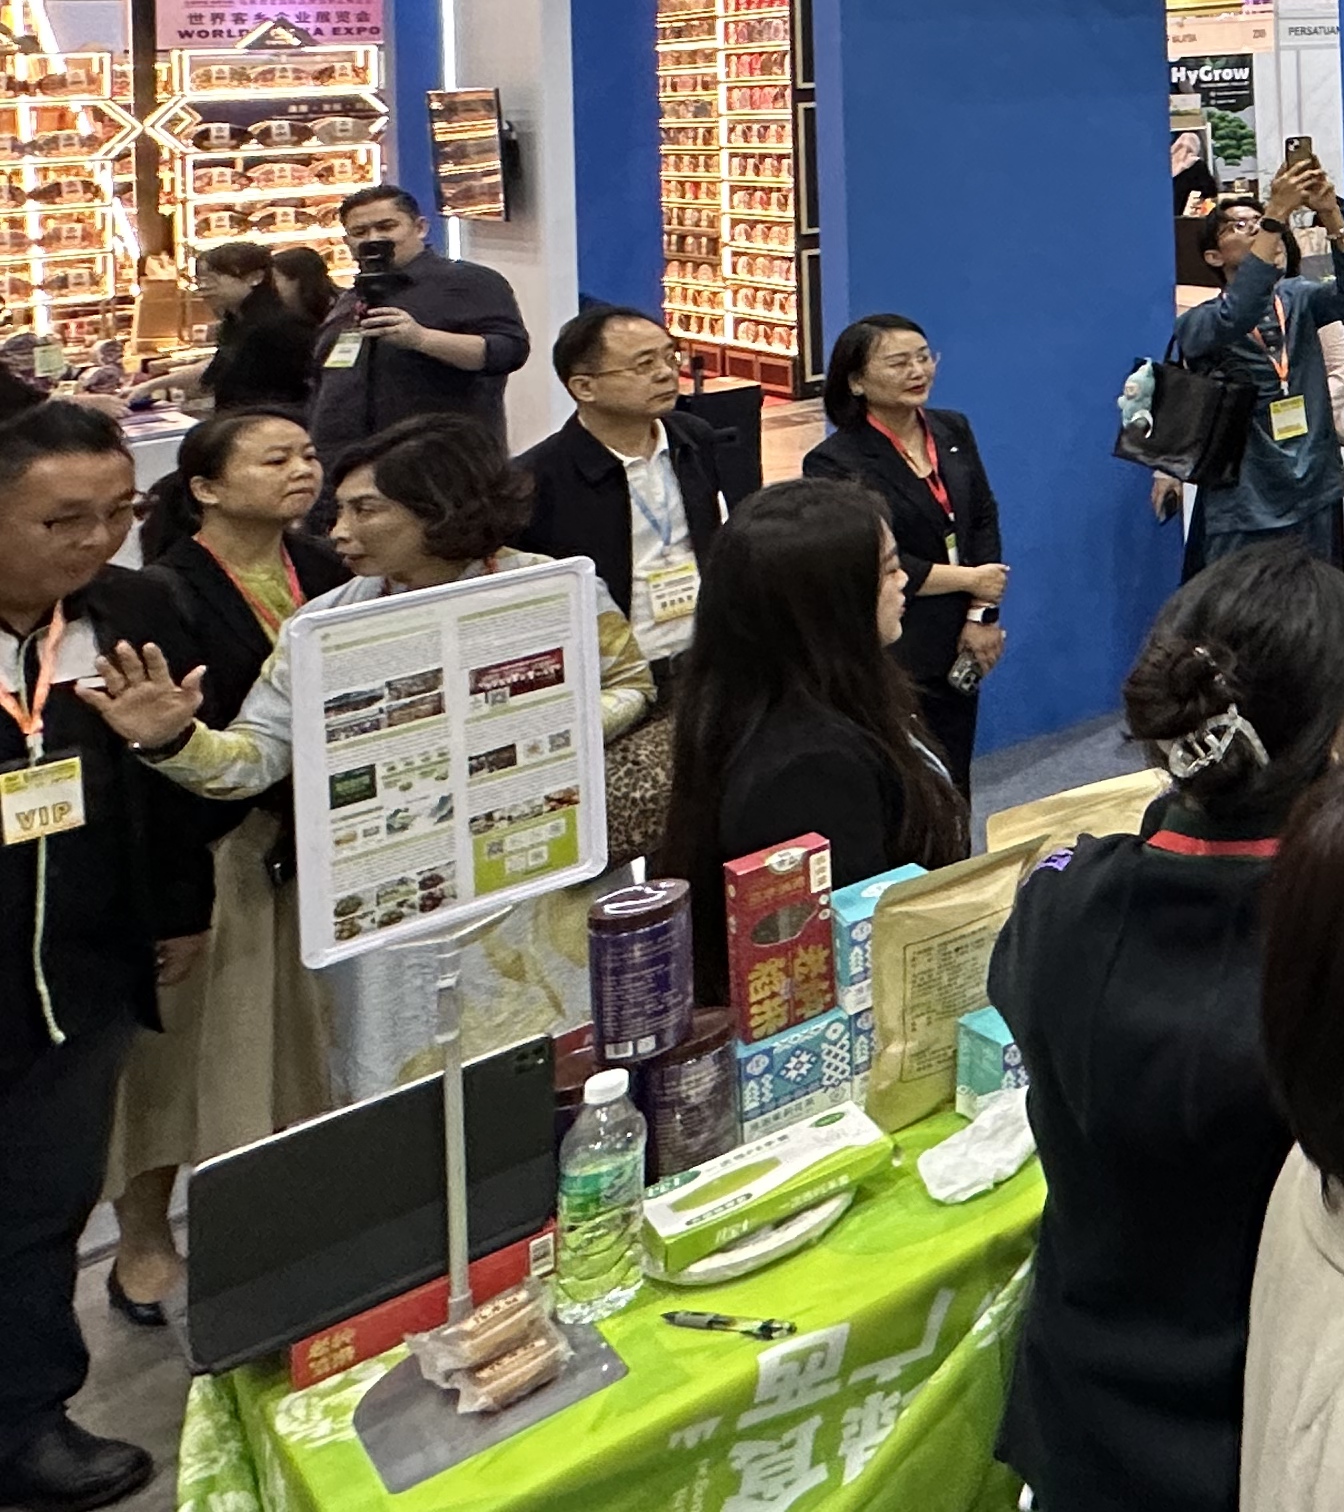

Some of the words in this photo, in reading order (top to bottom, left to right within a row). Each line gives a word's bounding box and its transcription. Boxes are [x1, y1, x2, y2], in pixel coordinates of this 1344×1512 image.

[332, 26, 381, 37] EXPO
[1170, 66, 1250, 89] HyGrow
[15, 800, 74, 831] VIP
